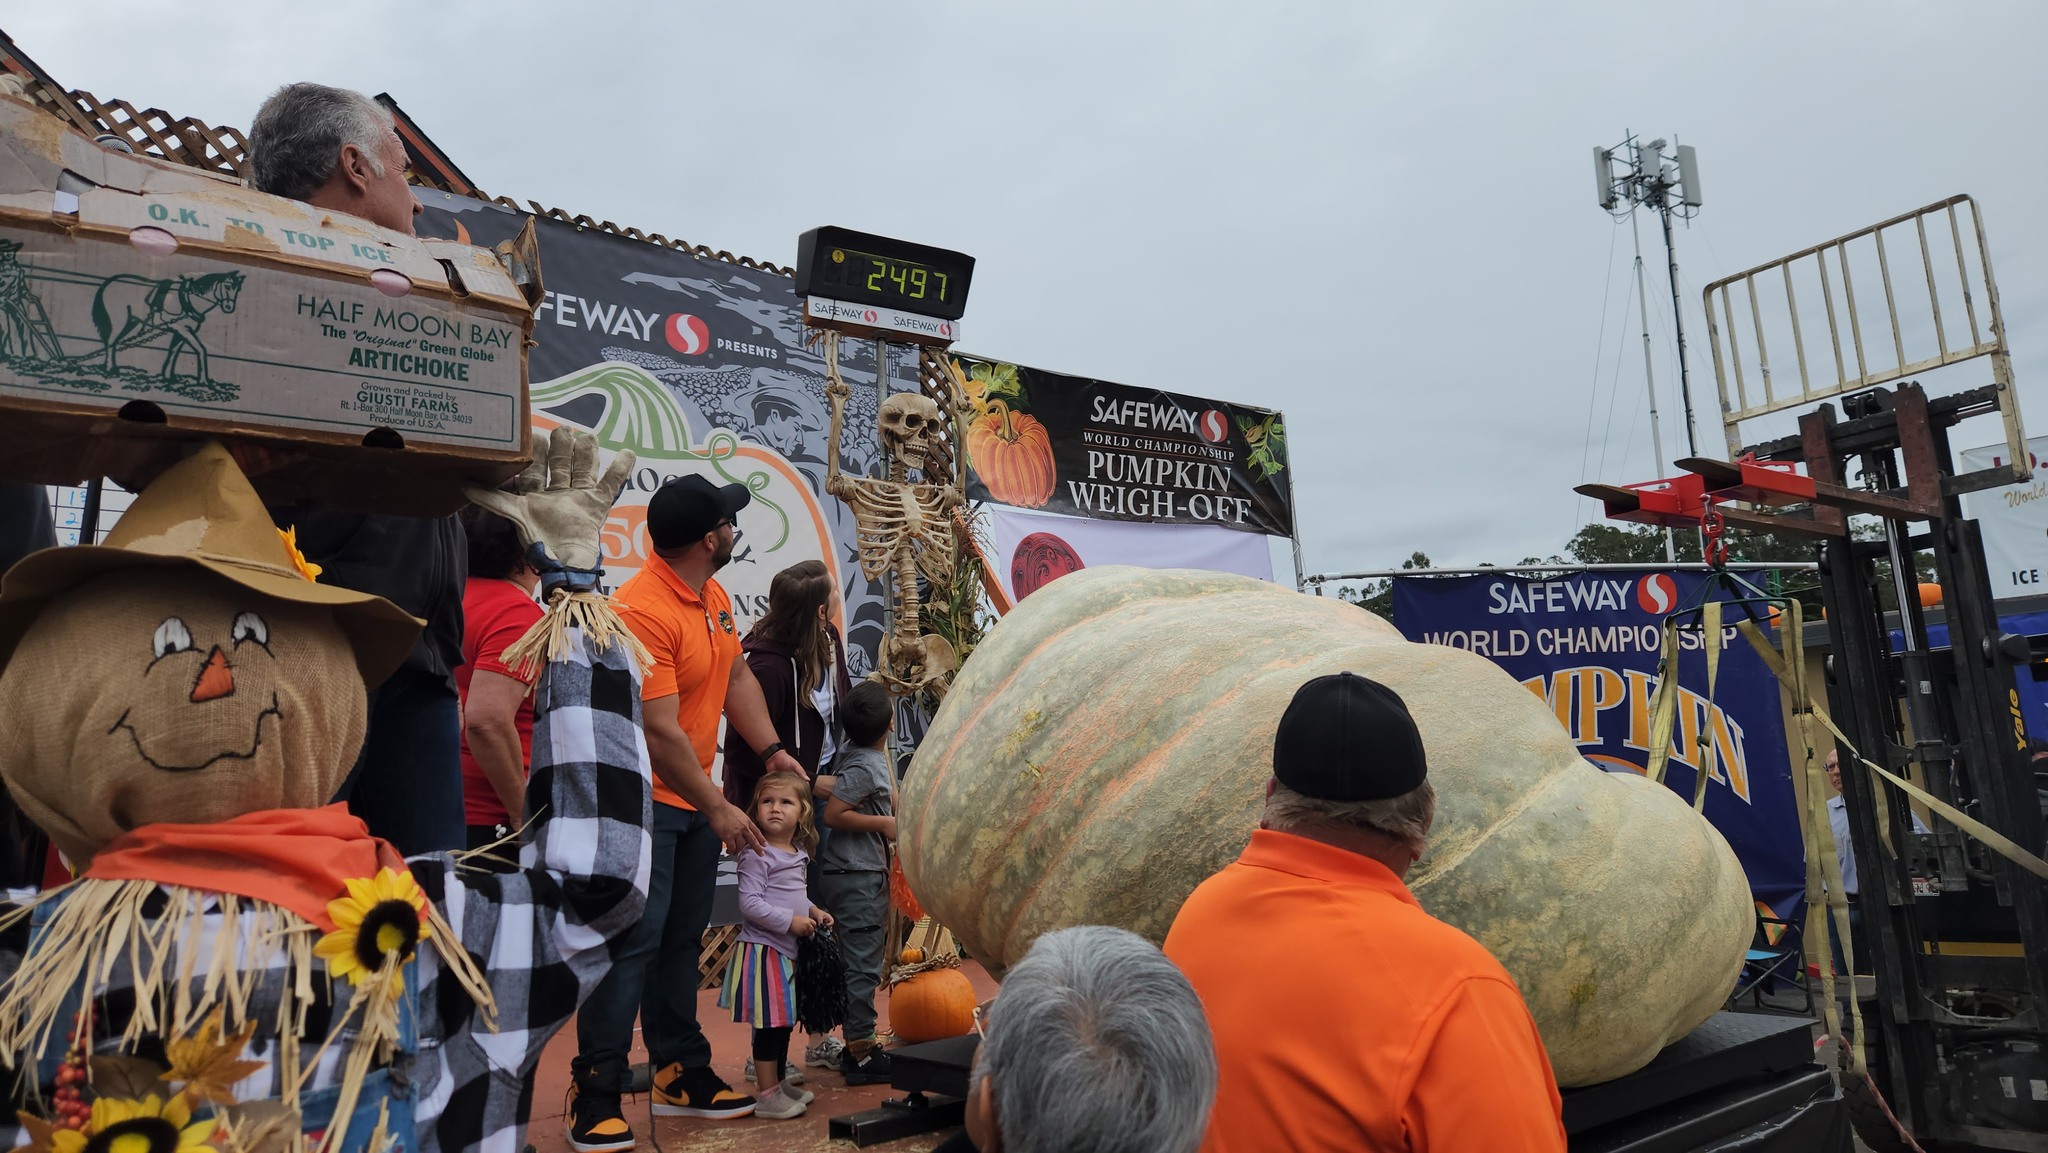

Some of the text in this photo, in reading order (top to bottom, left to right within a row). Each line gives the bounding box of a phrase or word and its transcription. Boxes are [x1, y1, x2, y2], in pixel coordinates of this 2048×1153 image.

[148, 203, 209, 228] O.K.
[280, 227, 335, 251] TOP
[351, 242, 395, 264] ICE
[867, 260, 948, 302] 2497
[297, 294, 513, 349] HALF MOON BAY
[534, 291, 660, 342] FEWAY
[814, 302, 940, 333] SAFEWAY SAFEWAY
[321, 323, 347, 340] The
[419, 339, 457, 356] Green
[460, 346, 495, 363] Globe
[717, 338, 778, 359] PRESENTS
[348, 346, 470, 382] ARTICHOKE
[356, 390, 459, 414] GIUSTI FARMS
[360, 381, 457, 403] Grown and Packed by
[340, 400, 473, 425] Rt. 1-Box 300 Half Moon Bay, Ca. 94019
[369, 413, 446, 430] Produce of U.S.A.
[1090, 395, 1198, 435] SAFEWAY
[1083, 432, 1235, 461] WORLD CHAMPIONSHIP
[1087, 450, 1232, 493] PUMPKIN
[65, 512, 79, 525] 2
[1067, 480, 1252, 524] WEIGH-OFF
[2012, 569, 2039, 586] ICE
[1488, 579, 1633, 615] SAFEWAY
[1423, 624, 1737, 658] WORLD CHAMPIOSP
[1520, 665, 1752, 806] MPKIN
[2009, 688, 2027, 751] Yale
